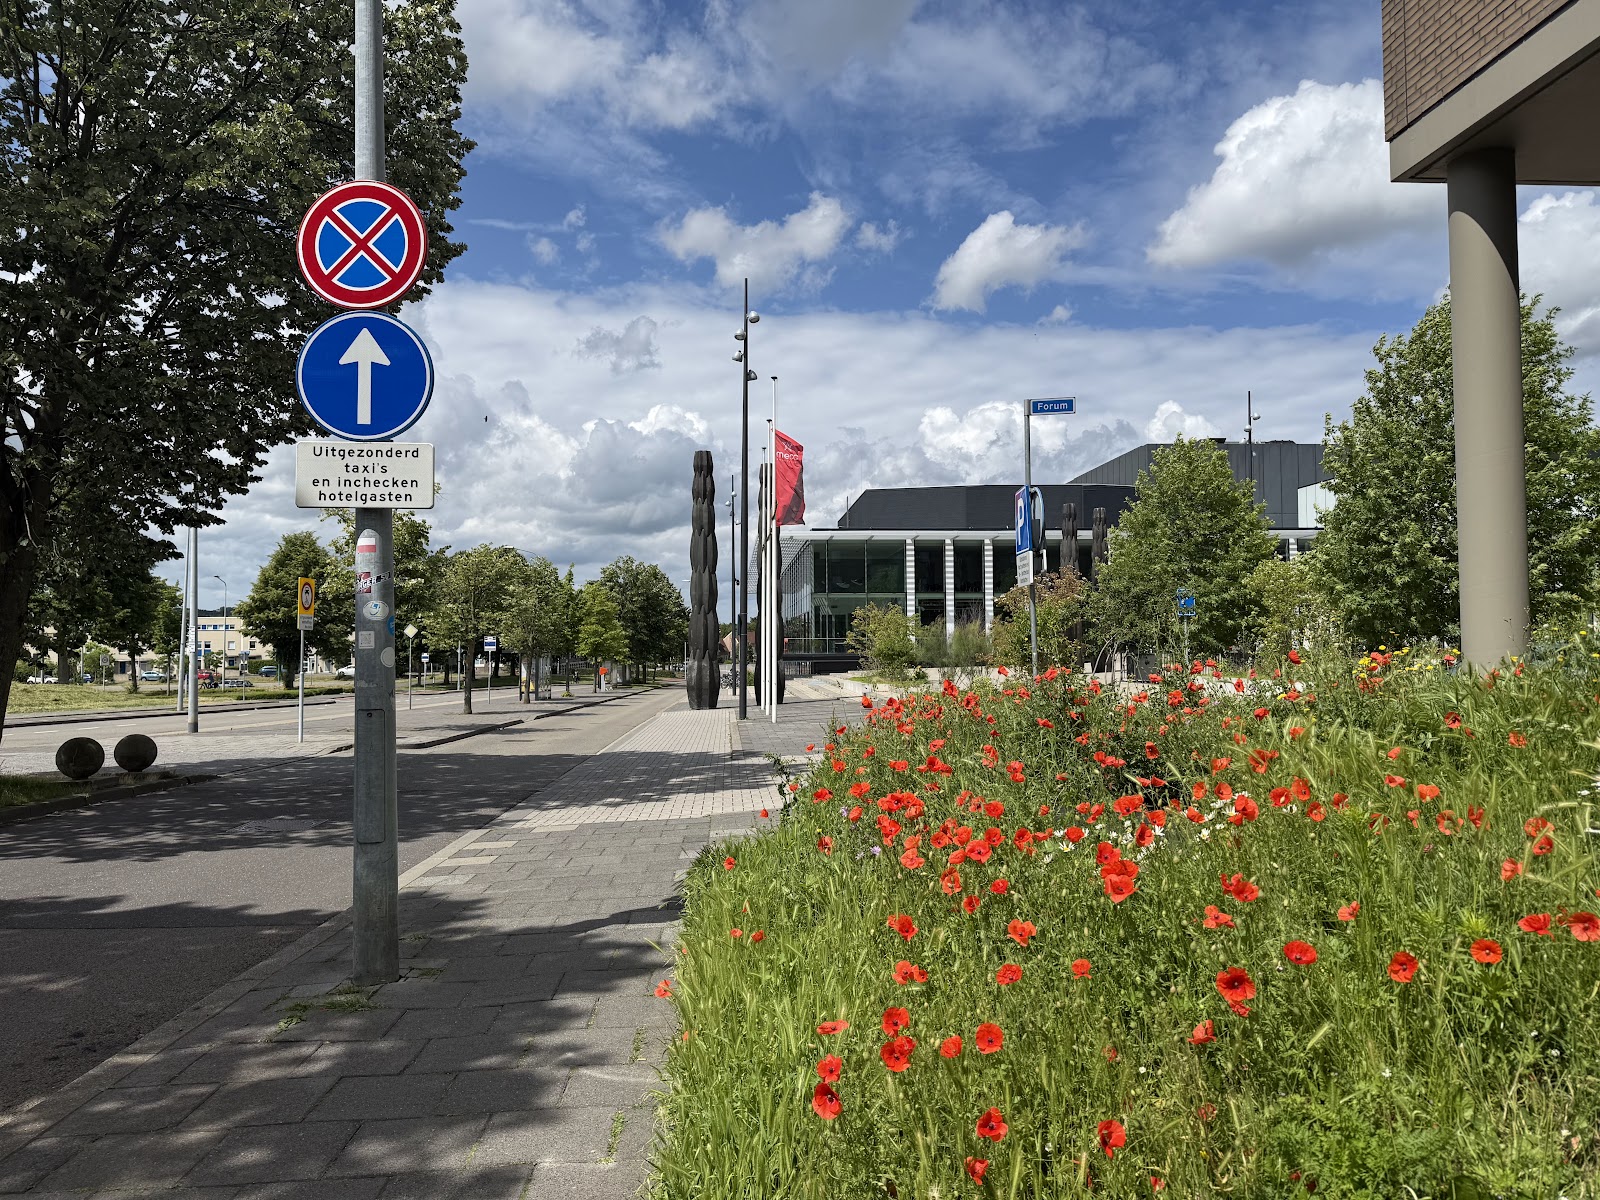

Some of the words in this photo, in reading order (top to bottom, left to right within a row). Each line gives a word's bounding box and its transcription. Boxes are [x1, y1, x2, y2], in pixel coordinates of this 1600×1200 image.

[1037, 402, 1068, 411] Forum
[313, 446, 419, 460] Uitgezonderd
[344, 462, 388, 473] taxi's
[312, 478, 330, 487] en
[338, 477, 418, 488] inchecken
[318, 491, 412, 504] hotelgasten
[1017, 497, 1025, 546] P
